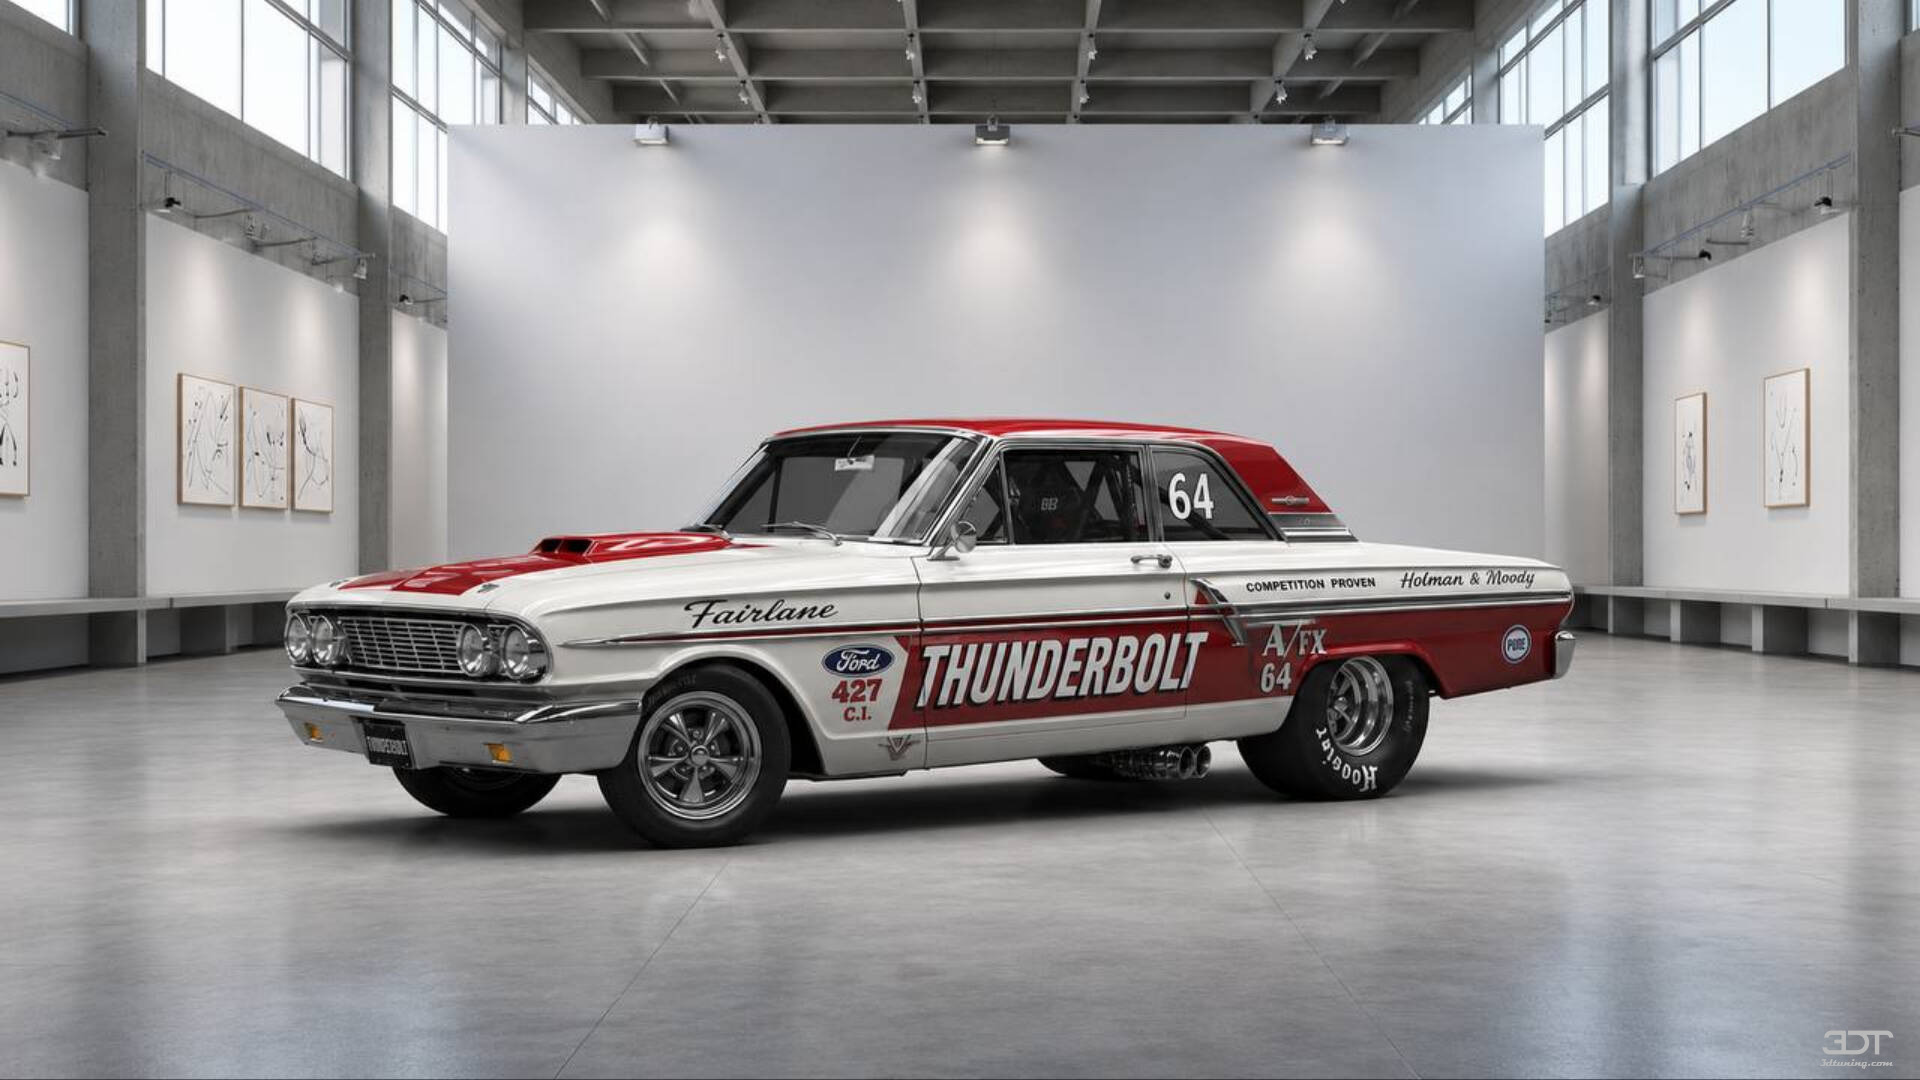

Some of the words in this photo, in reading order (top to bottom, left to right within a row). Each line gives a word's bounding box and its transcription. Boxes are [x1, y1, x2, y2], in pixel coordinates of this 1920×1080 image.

[1168, 472, 1214, 520] 64
[1246, 579, 1325, 592] COMPETITION
[1331, 577, 1376, 589] PROVEN
[1401, 571, 1463, 588] Holman
[1470, 572, 1479, 585] &
[1486, 570, 1535, 588] Moody
[684, 600, 838, 628] Fairlane
[837, 650, 879, 671] Ford
[916, 632, 1209, 710] THUNDERBOLT
[1260, 662, 1291, 693] 64
[832, 679, 882, 702] 427
[844, 707, 871, 721] C.I.
